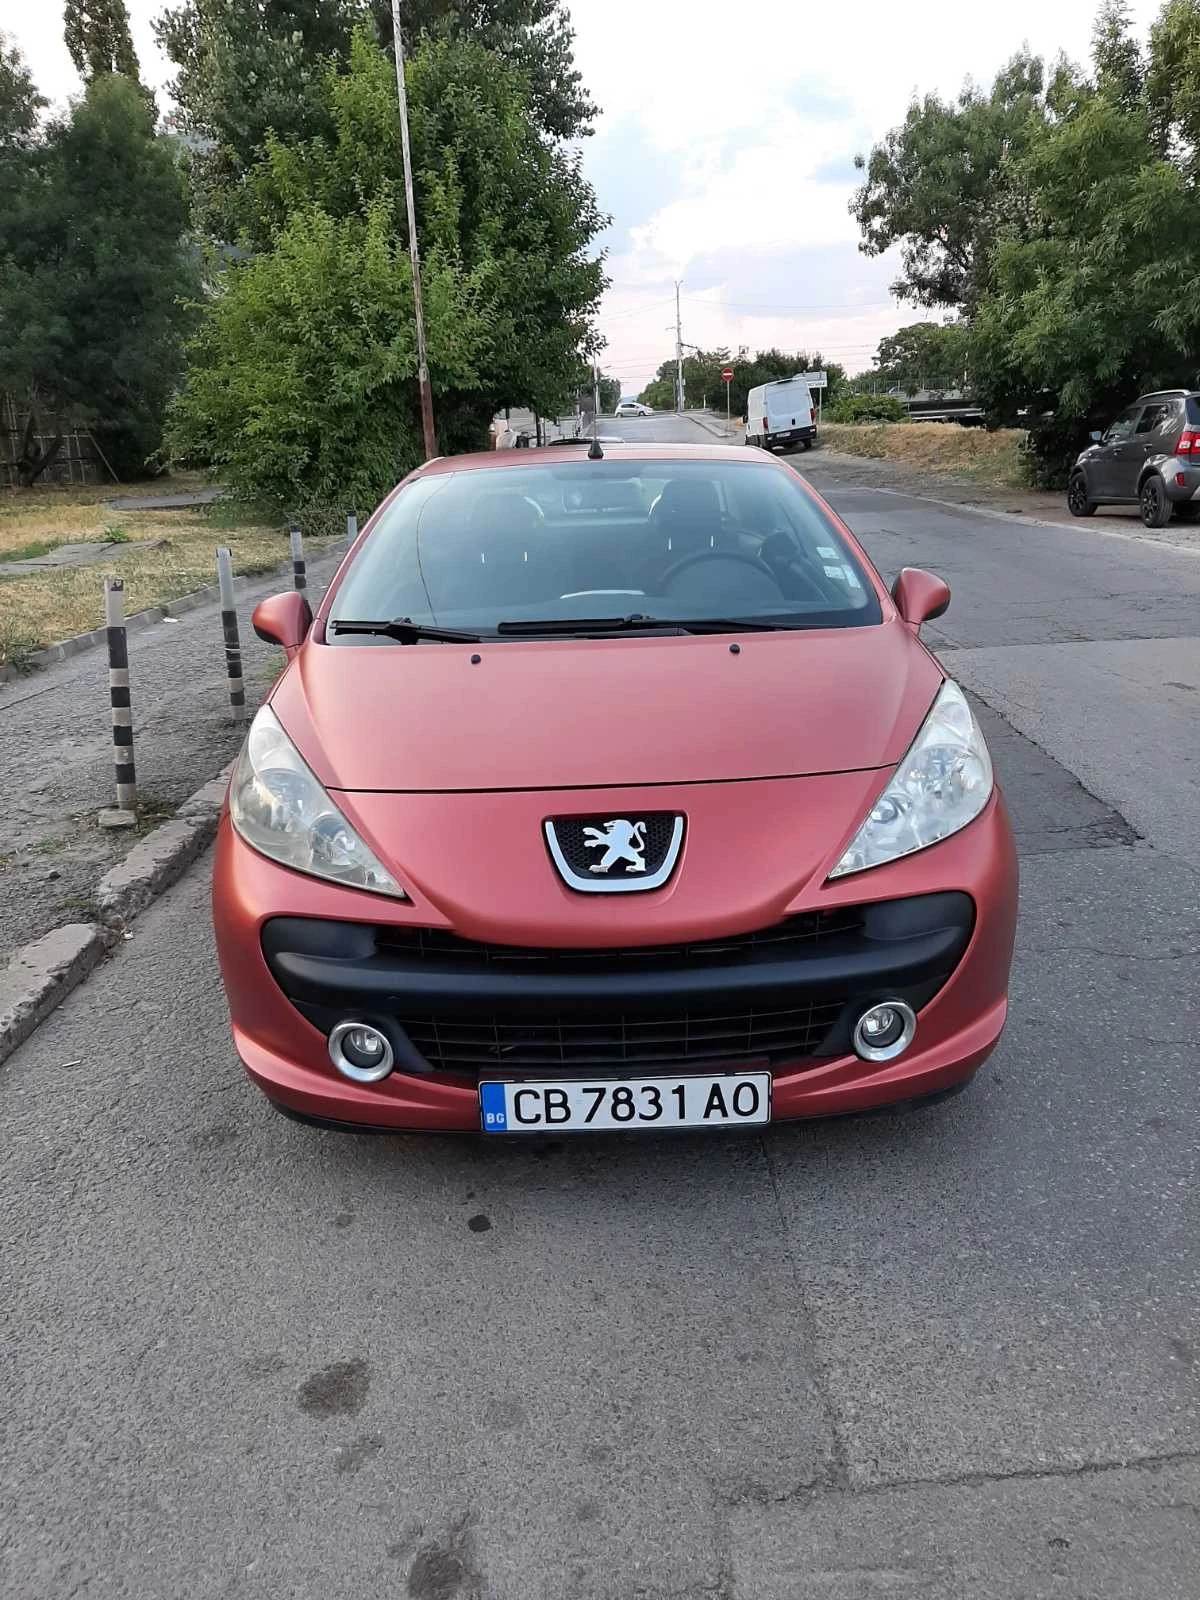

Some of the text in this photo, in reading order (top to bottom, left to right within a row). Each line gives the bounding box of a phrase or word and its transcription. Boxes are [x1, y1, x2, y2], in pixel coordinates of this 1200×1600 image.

[513, 1081, 760, 1124] CB 7831 AO
[486, 1112, 505, 1124] BG
